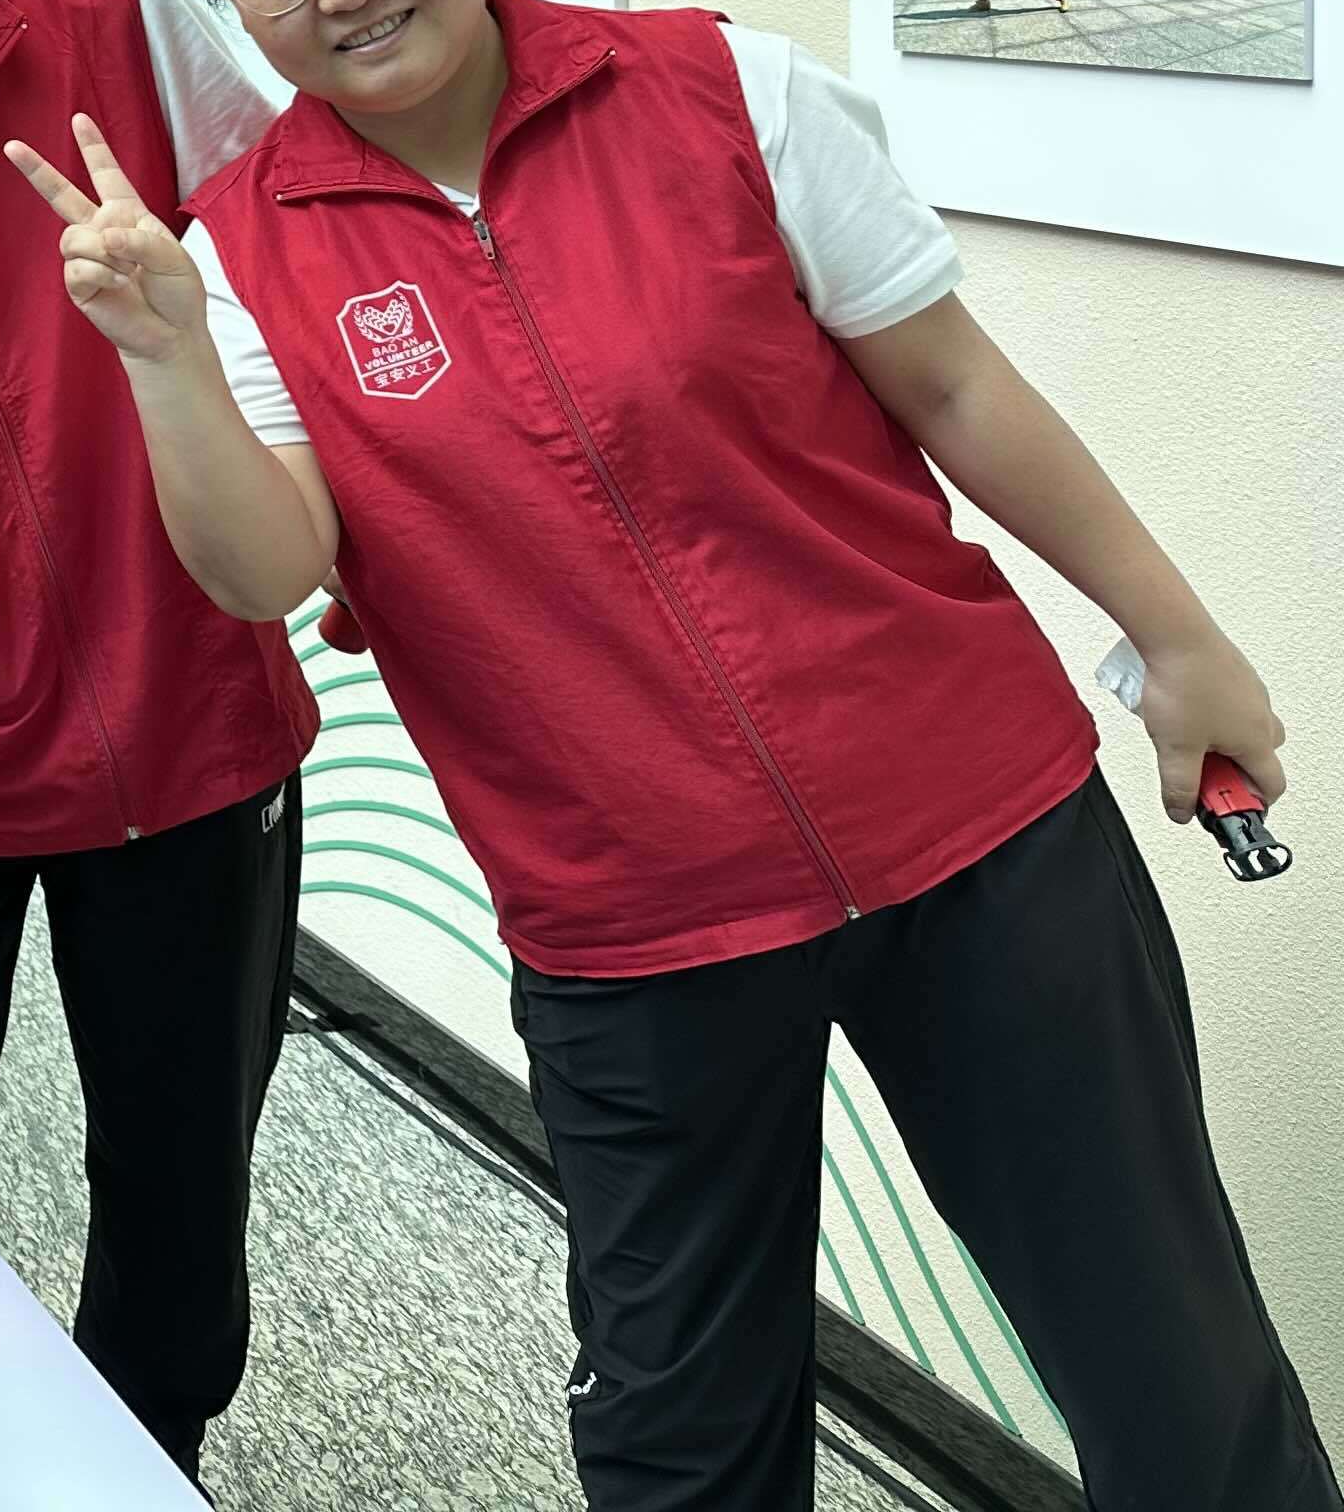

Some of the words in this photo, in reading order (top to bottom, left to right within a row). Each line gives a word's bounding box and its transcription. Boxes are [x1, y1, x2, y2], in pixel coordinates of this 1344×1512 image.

[364, 340, 434, 370] VOLUNTEER
[372, 343, 398, 357] BAO
[373, 358, 436, 389] 宝安义工
